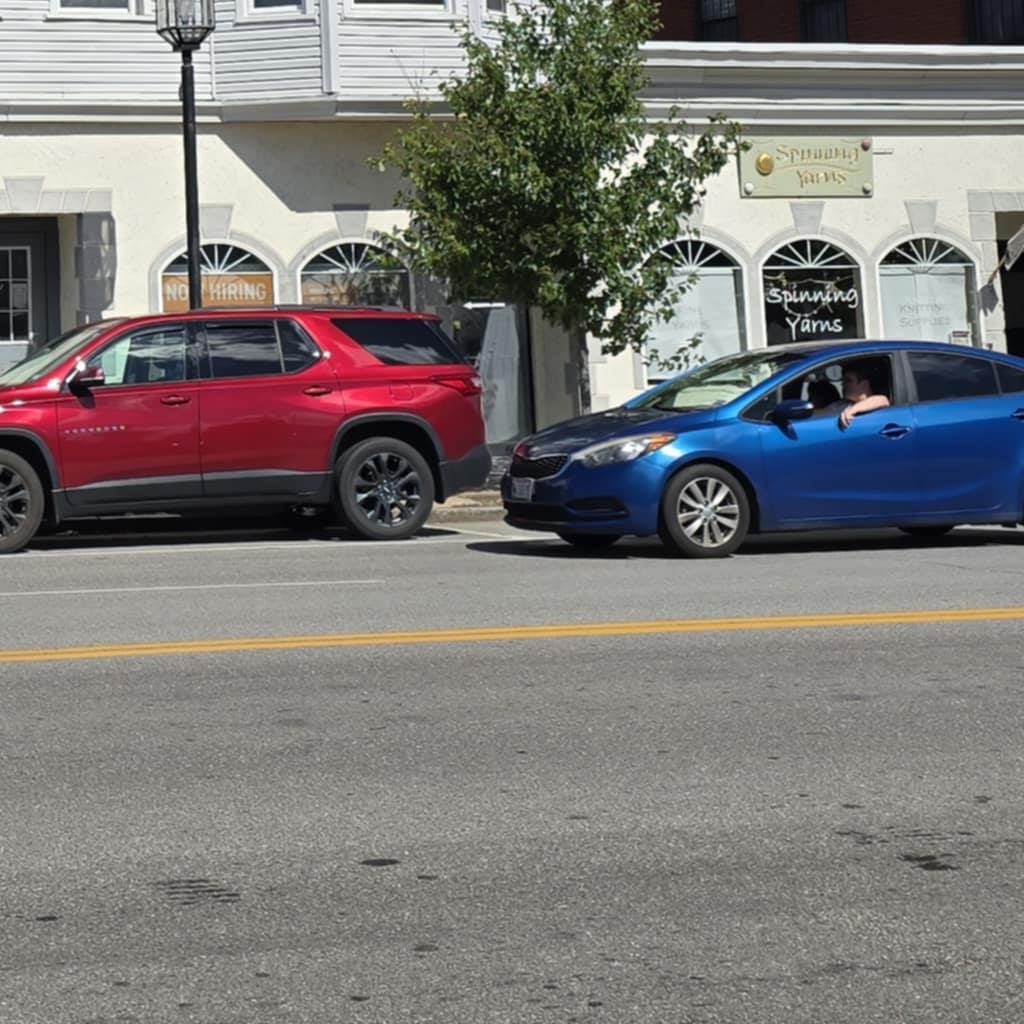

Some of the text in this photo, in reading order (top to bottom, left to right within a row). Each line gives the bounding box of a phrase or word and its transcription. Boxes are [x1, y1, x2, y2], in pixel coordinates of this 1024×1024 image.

[166, 281, 267, 302] NO HIRING
[766, 283, 859, 311] Spinning
[785, 315, 844, 341] Yarns
